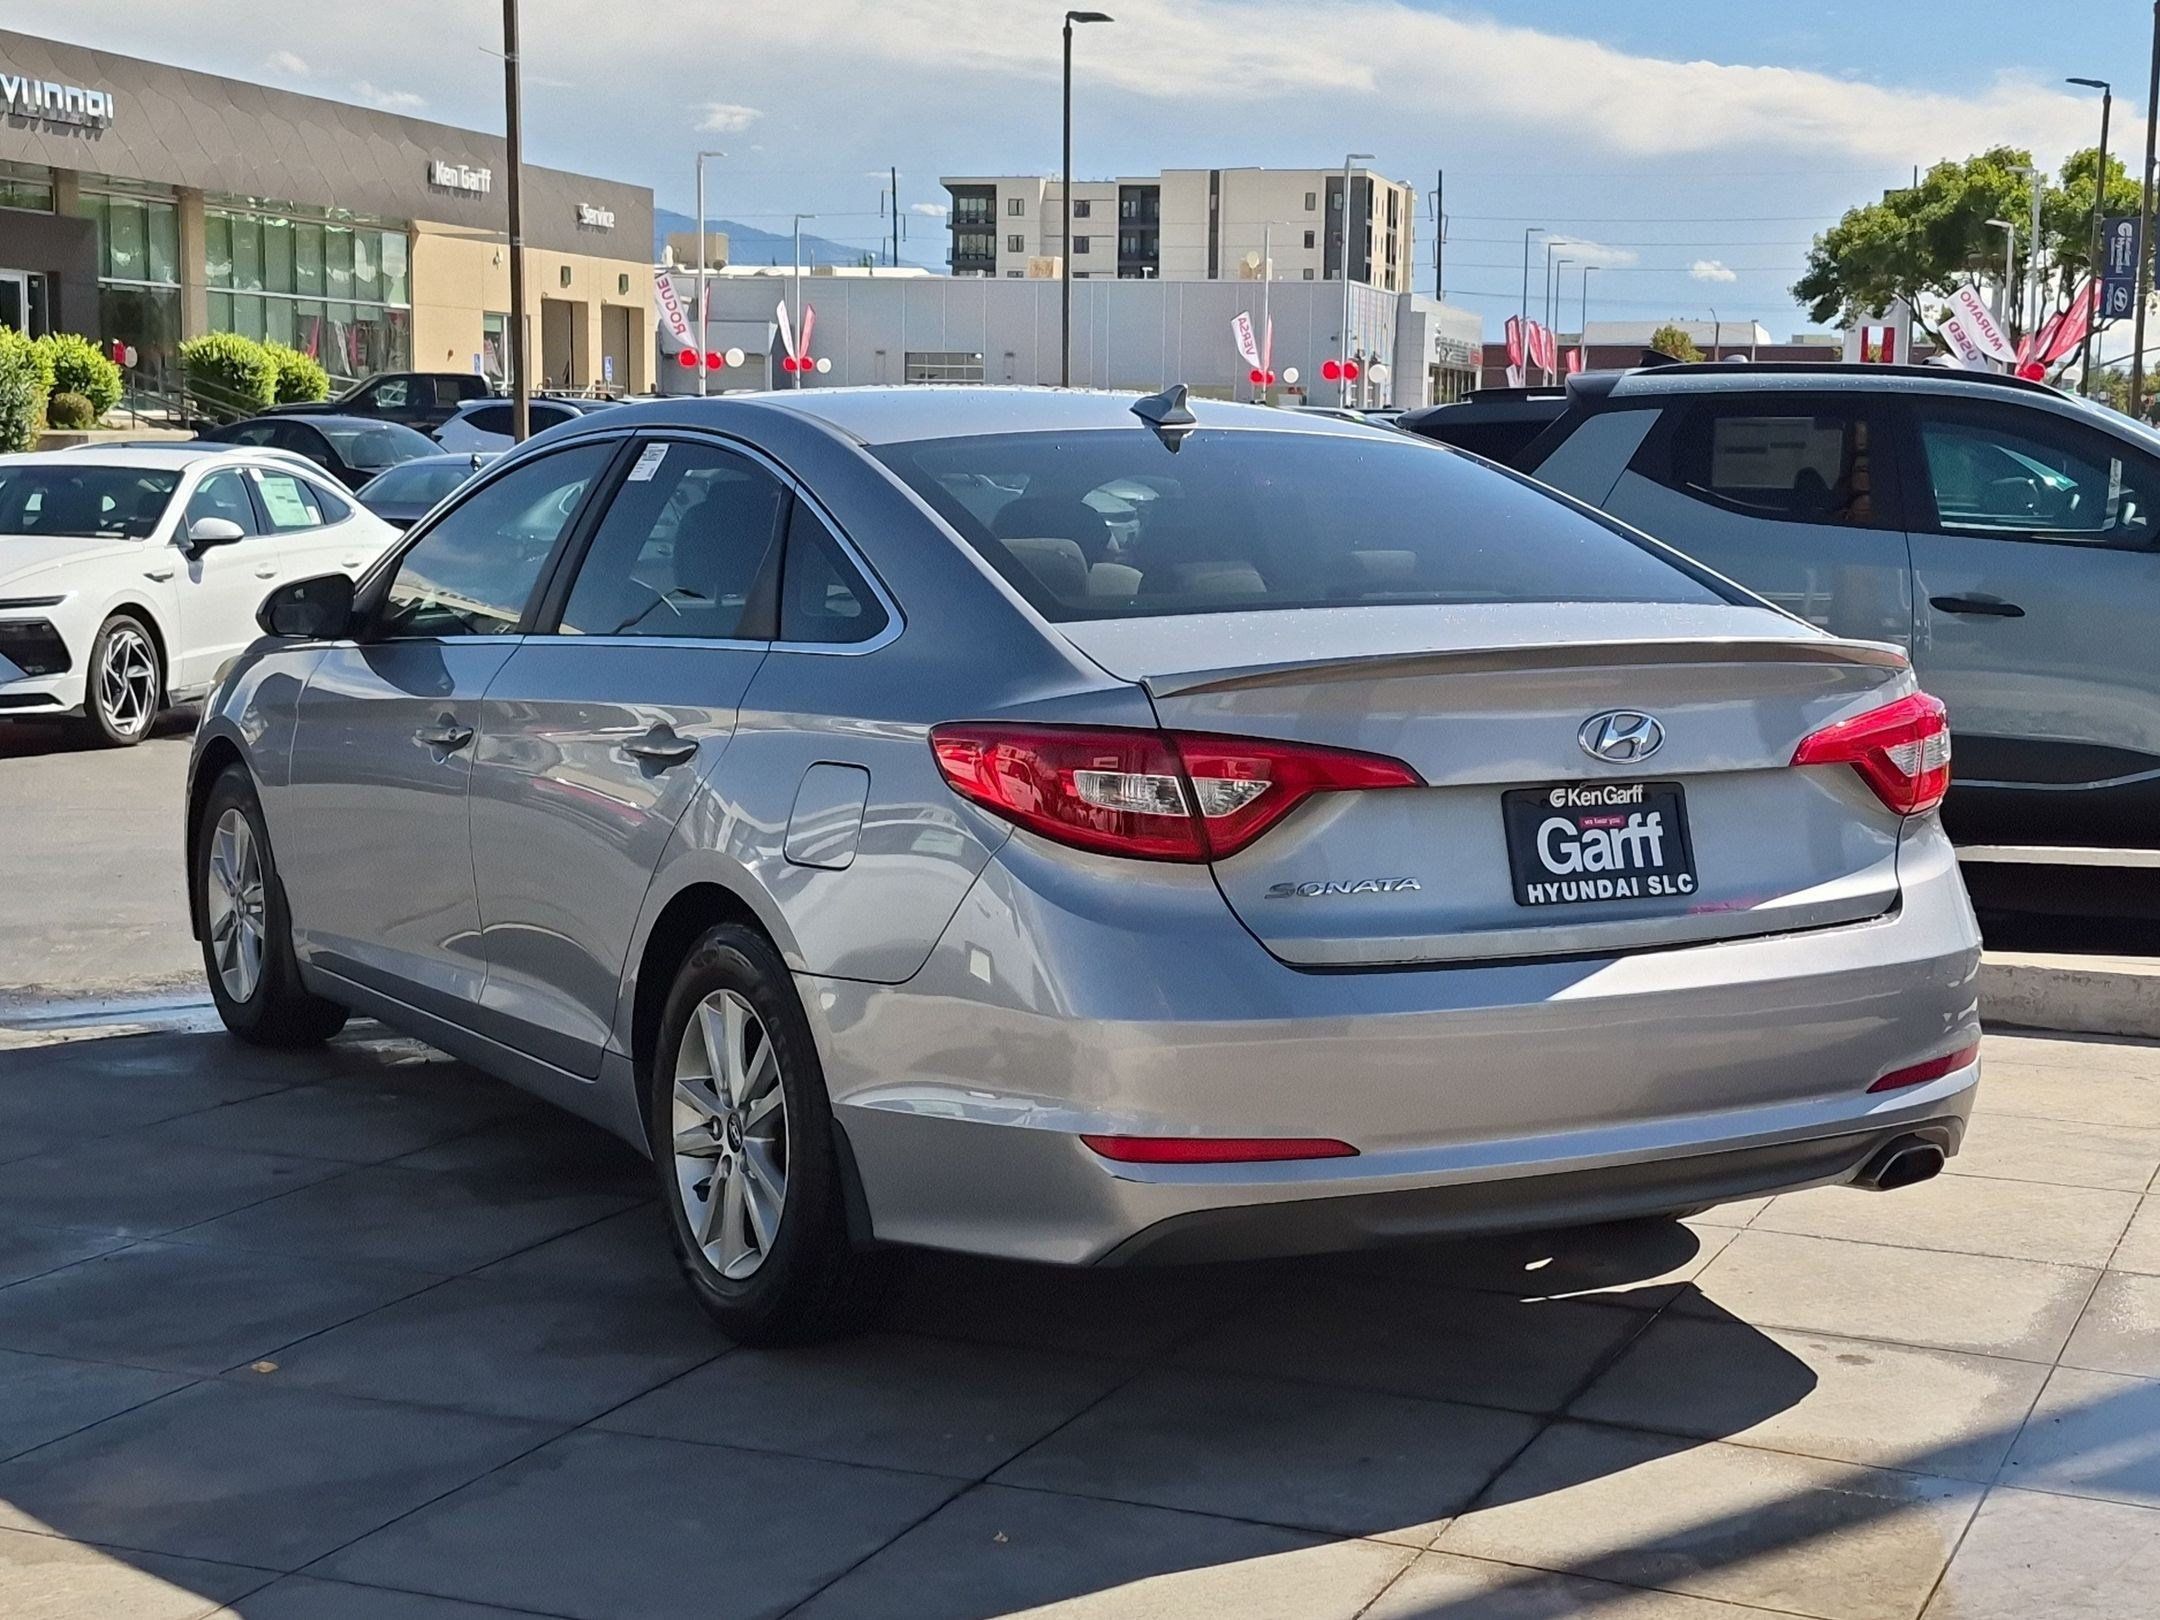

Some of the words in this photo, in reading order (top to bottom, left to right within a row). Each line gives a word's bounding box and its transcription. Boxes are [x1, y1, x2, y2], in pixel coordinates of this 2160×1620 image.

[579, 202, 615, 228] Service
[1536, 811, 1664, 875] Garff
[1264, 876, 1422, 899] SONATA
[1527, 877, 1640, 904] HYUNDAI
[1648, 873, 1694, 896] SLC
